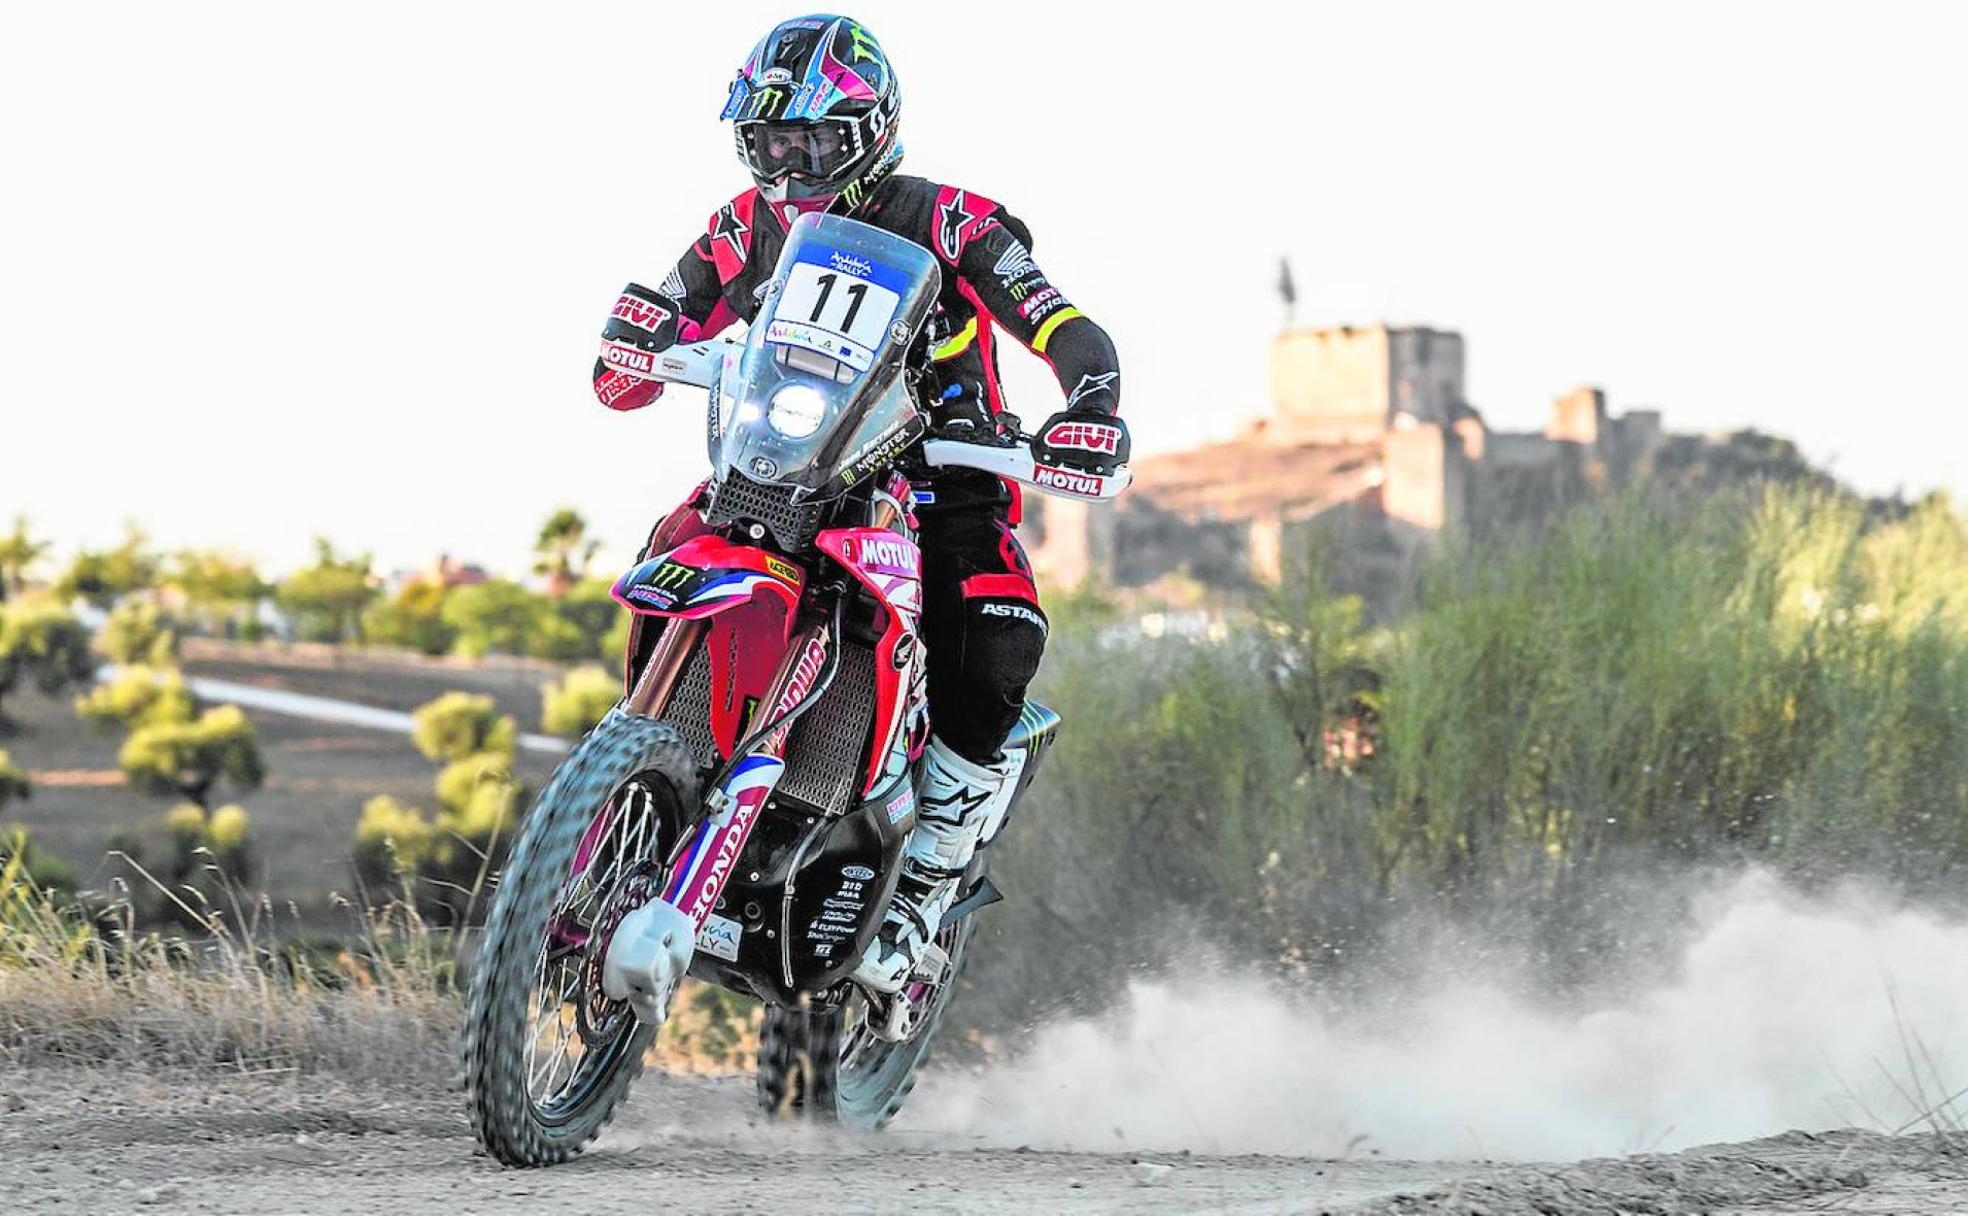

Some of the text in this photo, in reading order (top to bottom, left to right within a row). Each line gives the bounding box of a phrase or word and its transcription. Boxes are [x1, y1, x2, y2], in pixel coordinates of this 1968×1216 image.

[614, 295, 668, 331] GIVI
[809, 273, 869, 334] 11
[1047, 425, 1118, 453] GIVI
[1036, 470, 1099, 495] MOTUL
[861, 538, 918, 569] MOTUL
[690, 805, 756, 932] HONDA
